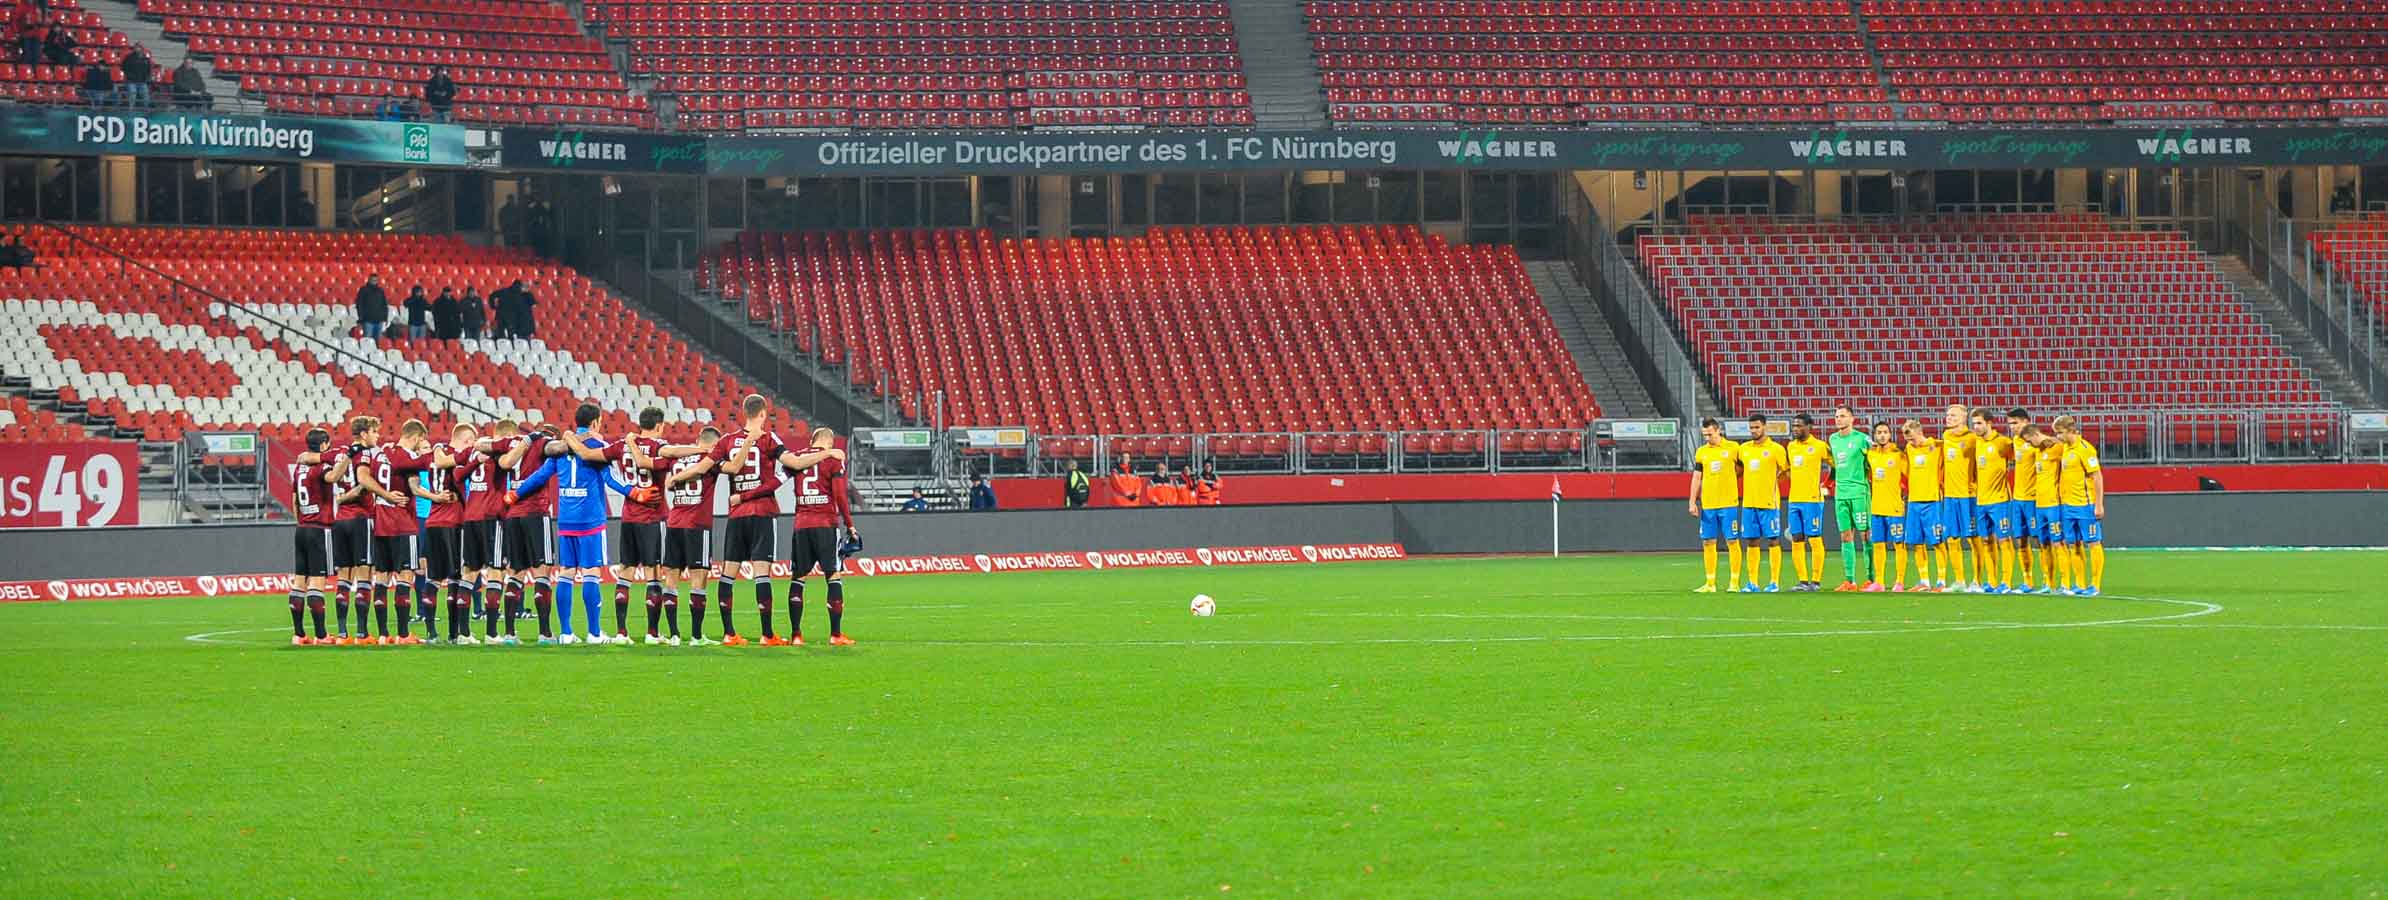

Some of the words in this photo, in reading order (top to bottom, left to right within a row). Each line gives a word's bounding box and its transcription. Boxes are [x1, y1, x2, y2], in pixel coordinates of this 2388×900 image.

[78, 115, 125, 143] PSD
[133, 116, 194, 145] Bank
[201, 118, 314, 157] Nürnberg
[539, 140, 627, 161] WAGNER
[818, 141, 948, 165] Offizieller
[955, 140, 1126, 169] Druckpartner
[1139, 139, 1187, 161] des
[1196, 139, 1218, 161] 1.
[1227, 137, 1263, 160] FC
[1272, 136, 1396, 164] Nürnberg
[1438, 140, 1557, 158] WAGNER
[1789, 140, 1907, 157] WAGNER
[2136, 138, 2252, 155] WAGNER
[377, 463, 392, 493] 9
[567, 454, 577, 489] 1
[802, 463, 820, 496] 2
[38, 453, 124, 529] 49
[297, 473, 310, 506] 6
[992, 552, 1083, 569] WOLFMÖBEL
[1103, 550, 1193, 566] WOLFMÖBEL
[1214, 546, 1298, 562] WOLFMÖBEL
[1318, 544, 1403, 560] WOLFMÖBEL
[876, 555, 971, 573] WOLFMÖBEL
[72, 578, 192, 598] WOLFMÖBEL
